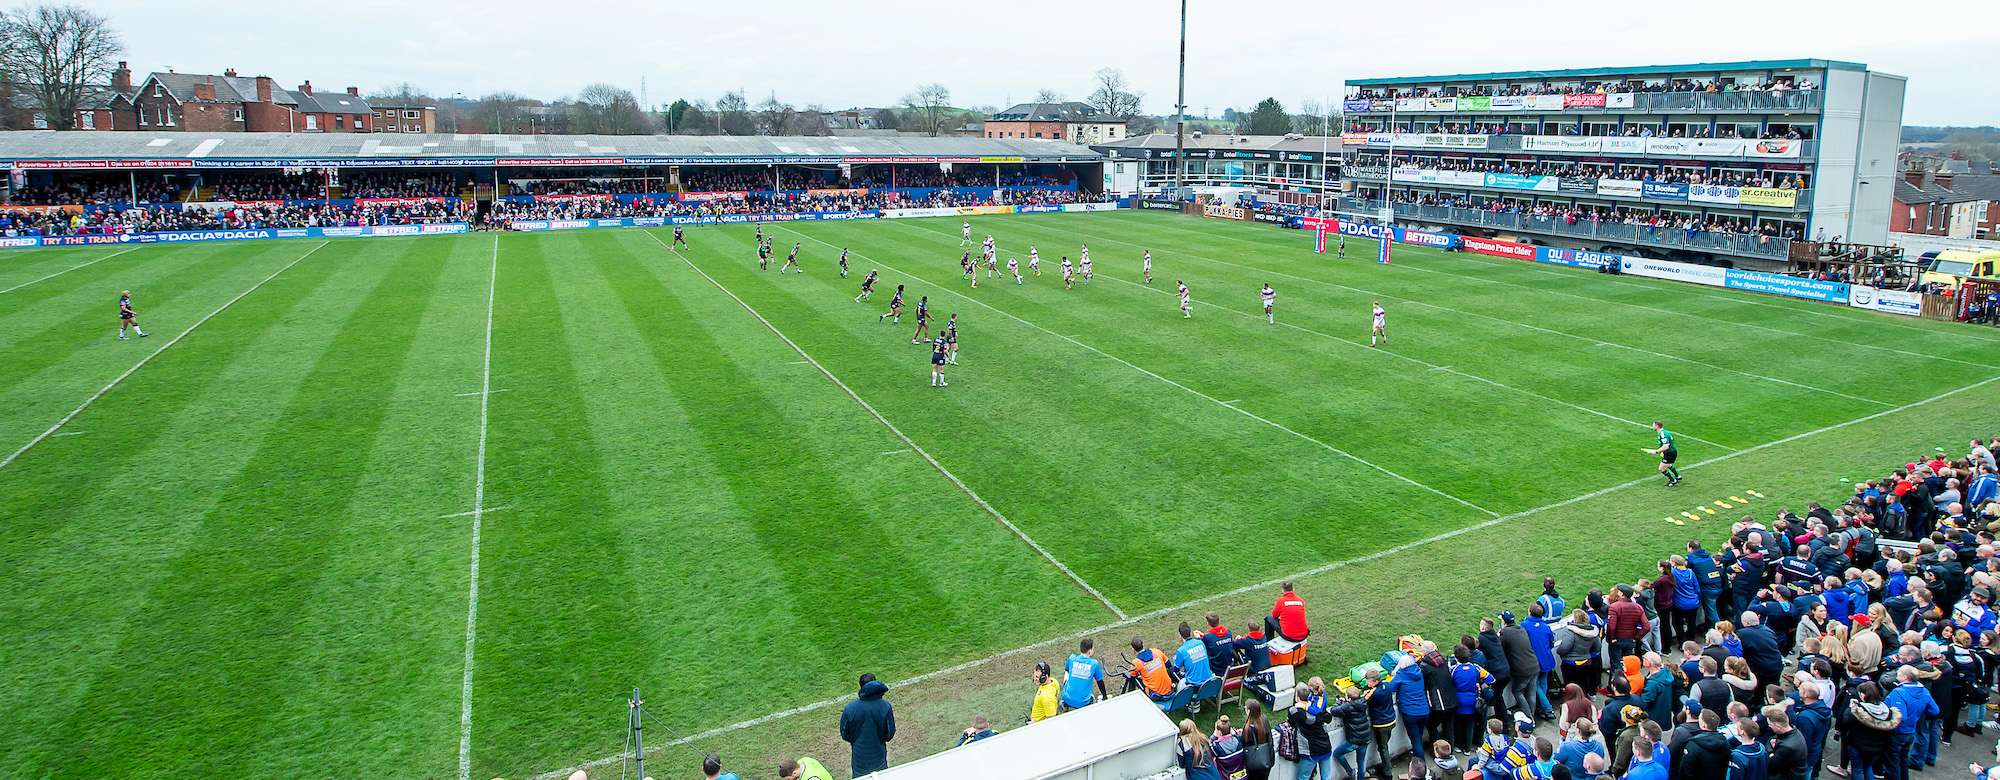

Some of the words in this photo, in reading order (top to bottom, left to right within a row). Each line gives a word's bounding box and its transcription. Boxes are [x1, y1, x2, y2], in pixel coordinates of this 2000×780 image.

[1742, 188, 1795, 198] sr.creative
[422, 224, 466, 233] BETFRED
[1304, 220, 1316, 228] sports
[224, 230, 270, 239] DACIA
[375, 226, 419, 234] BETFRED
[42, 238, 62, 246] TRY
[65, 236, 84, 244] THE
[88, 236, 118, 244] TRAIN
[168, 232, 216, 241] DACIA
[1406, 232, 1449, 245] BETFRED
[1464, 239, 1496, 251] Kingstone
[1496, 244, 1514, 254] Press
[1514, 247, 1532, 256] Cider
[1548, 248, 1612, 266] OURLEAGUE
[1644, 264, 1680, 274] ONEWORLD
[1680, 269, 1702, 278] TRAVEL
[1702, 272, 1724, 280] GROUP
[1726, 271, 1833, 290] worldchoicesports.com
[1743, 282, 1766, 291] Sports
[1768, 284, 1790, 294] Travel
[1790, 286, 1826, 299] Specialist
[1186, 644, 1204, 656] WATER
[1072, 661, 1092, 671] WATER
